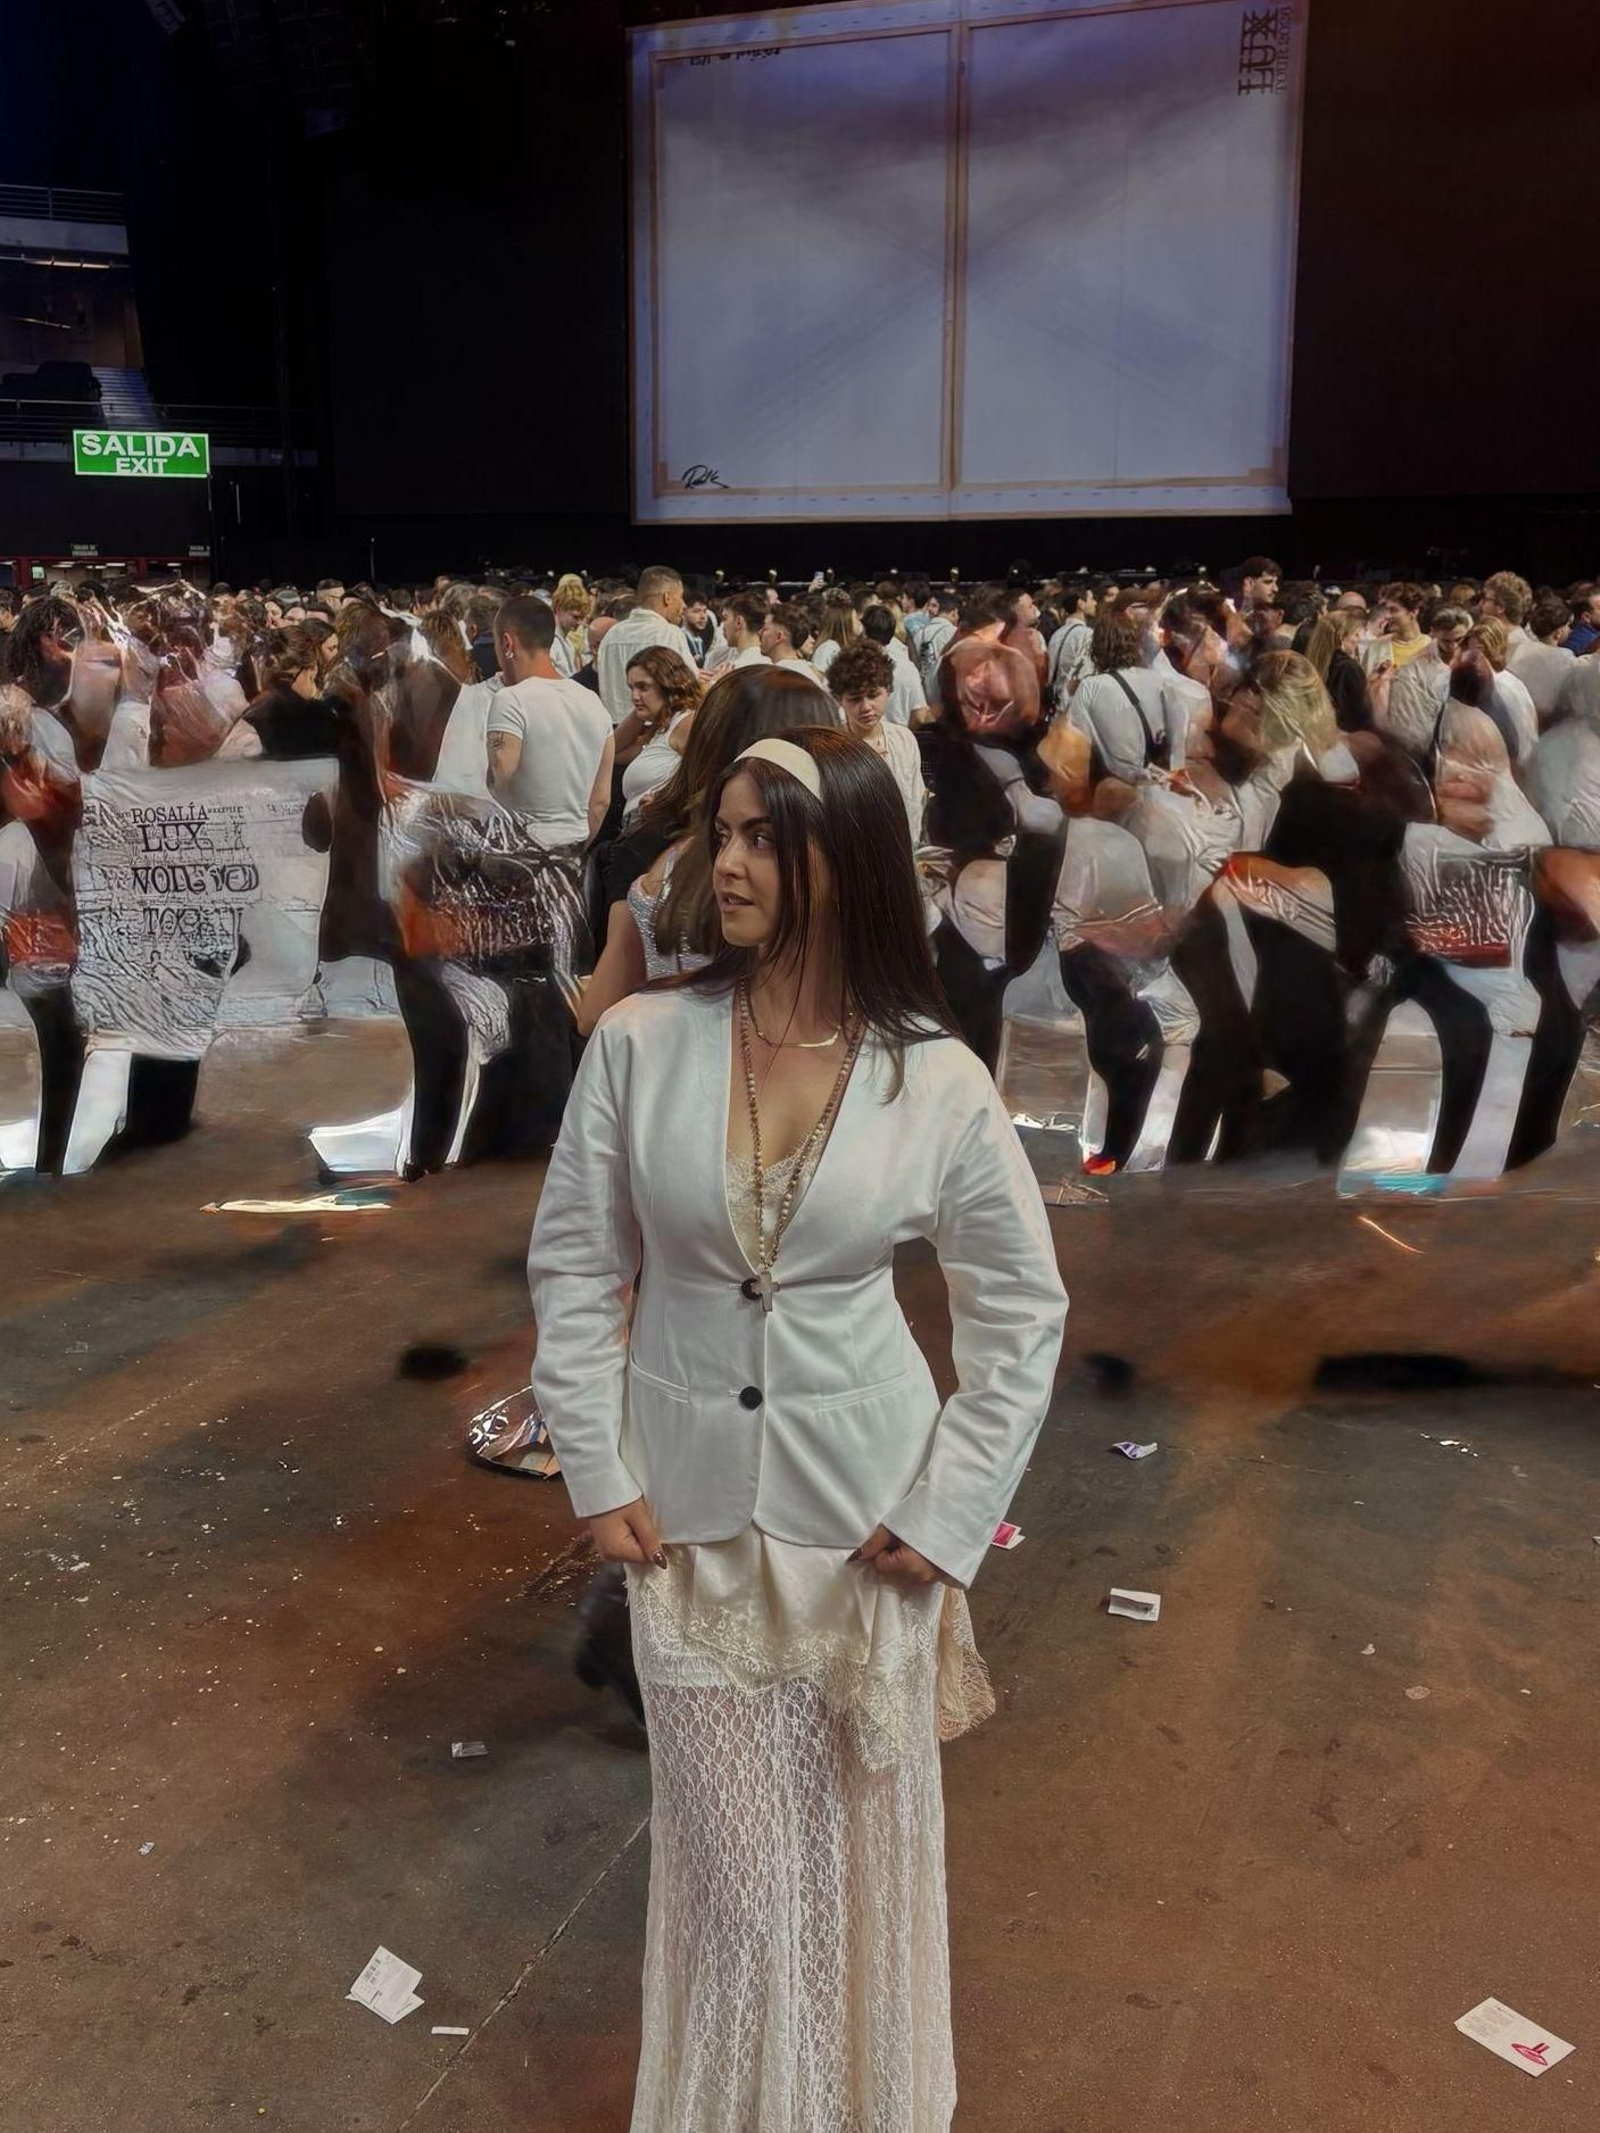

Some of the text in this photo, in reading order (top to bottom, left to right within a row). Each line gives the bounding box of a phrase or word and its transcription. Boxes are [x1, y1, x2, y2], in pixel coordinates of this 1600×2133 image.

[1237, 7, 1278, 96] LUX
[81, 434, 200, 458] SALIDA
[116, 457, 168, 474] EXIT
[132, 803, 209, 824] ROSALÍA
